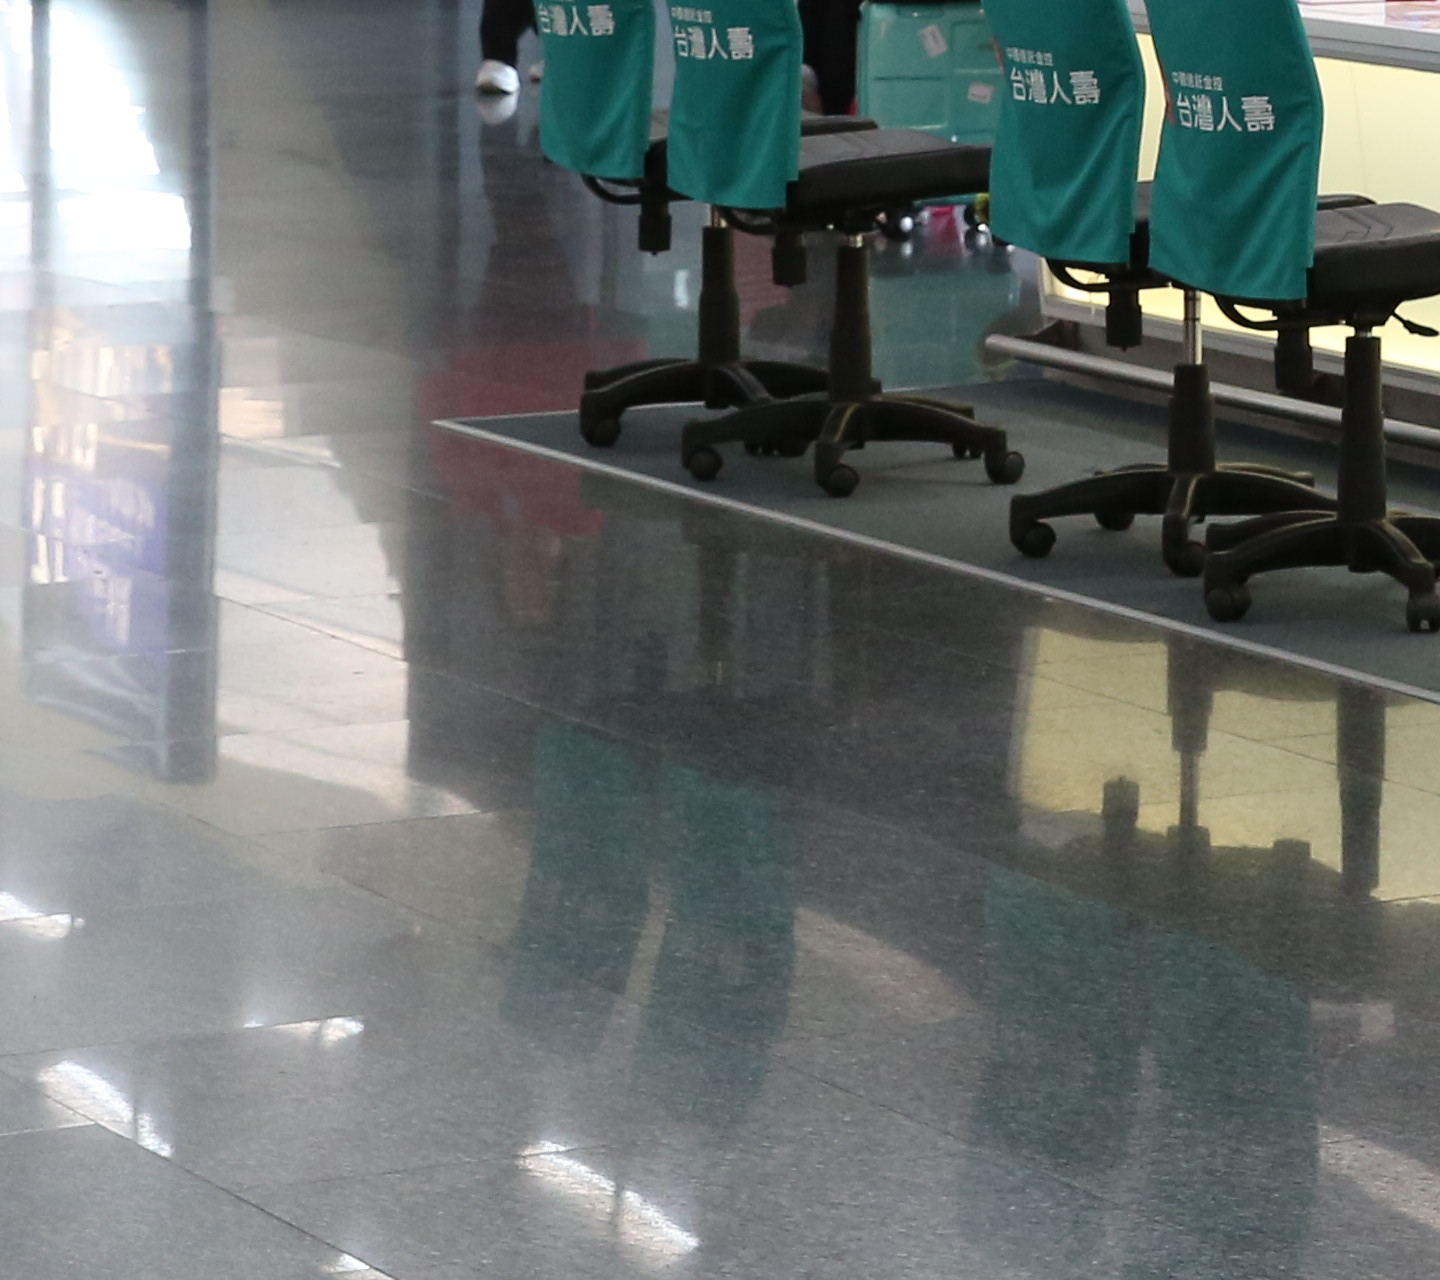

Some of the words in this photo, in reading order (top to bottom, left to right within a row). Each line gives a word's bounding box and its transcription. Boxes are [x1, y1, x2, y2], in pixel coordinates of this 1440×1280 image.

[673, 25, 756, 61] 台灣人壽
[1009, 66, 1102, 107] 台灣人壽
[1175, 92, 1277, 133] 台灣人壽
